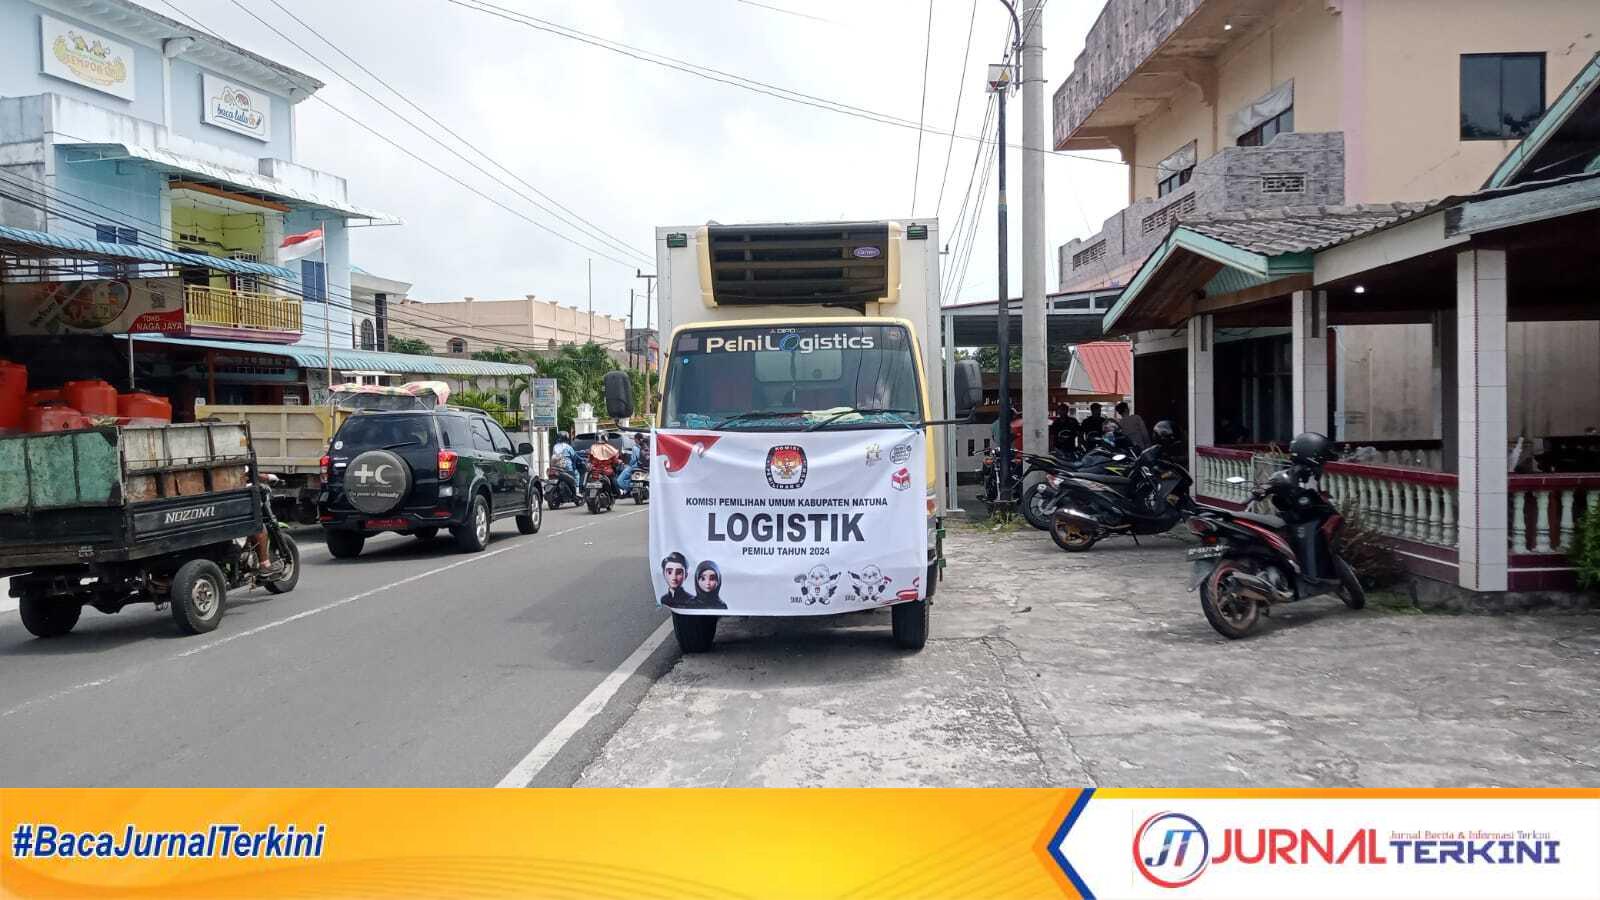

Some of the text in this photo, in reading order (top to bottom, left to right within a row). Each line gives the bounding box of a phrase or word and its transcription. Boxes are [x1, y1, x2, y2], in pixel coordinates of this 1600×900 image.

[137, 322, 183, 331] NAGA JAYA
[706, 335, 762, 353] Pelni
[686, 497, 888, 507] KOMISI PEMILIHAN UMUM KABUPATEN NATUNA
[164, 505, 216, 525] NOZOMI
[708, 512, 865, 542] LOGISTIK
[742, 547, 830, 556] PEMILU TAHUN 2024
